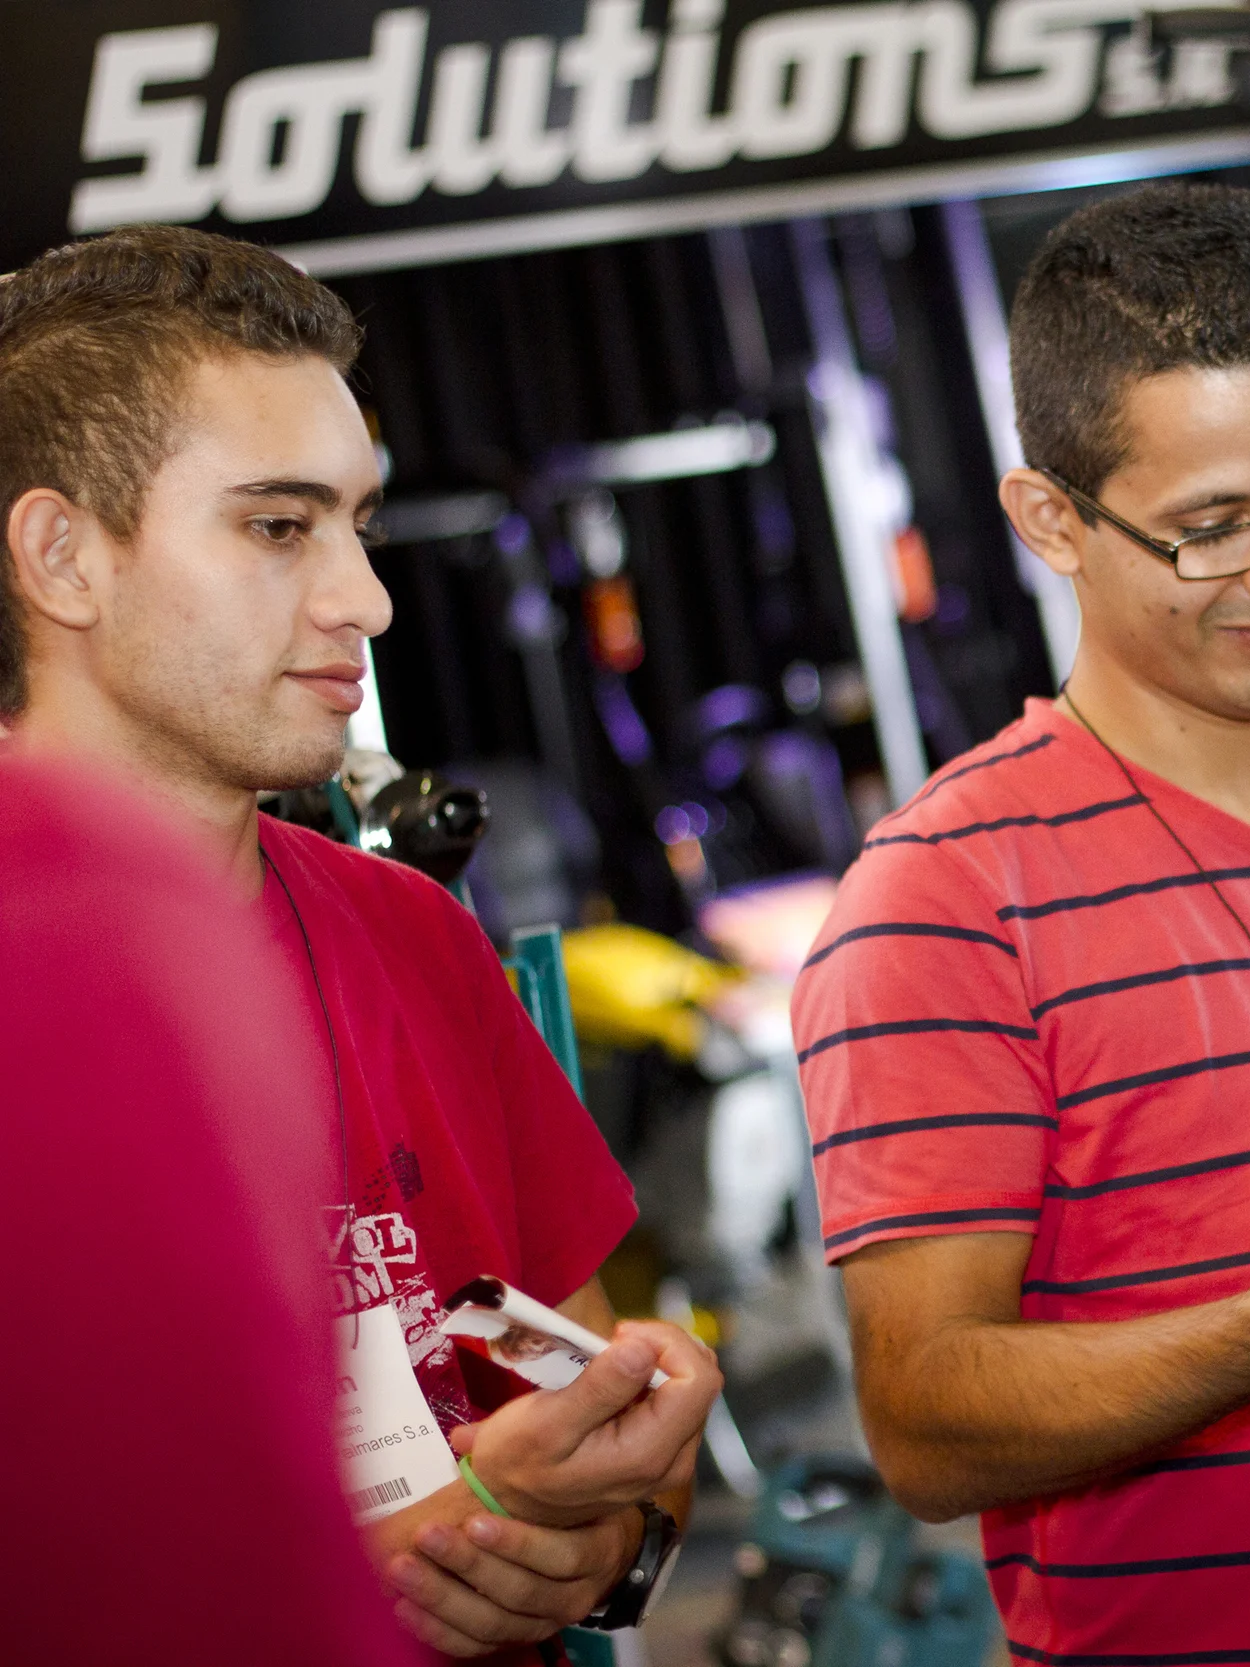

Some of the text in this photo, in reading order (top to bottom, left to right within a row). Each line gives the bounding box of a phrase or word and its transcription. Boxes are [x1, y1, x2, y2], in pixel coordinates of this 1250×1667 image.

[66, 0, 1148, 236] Solutions
[340, 1424, 435, 1460] almares S.a.
